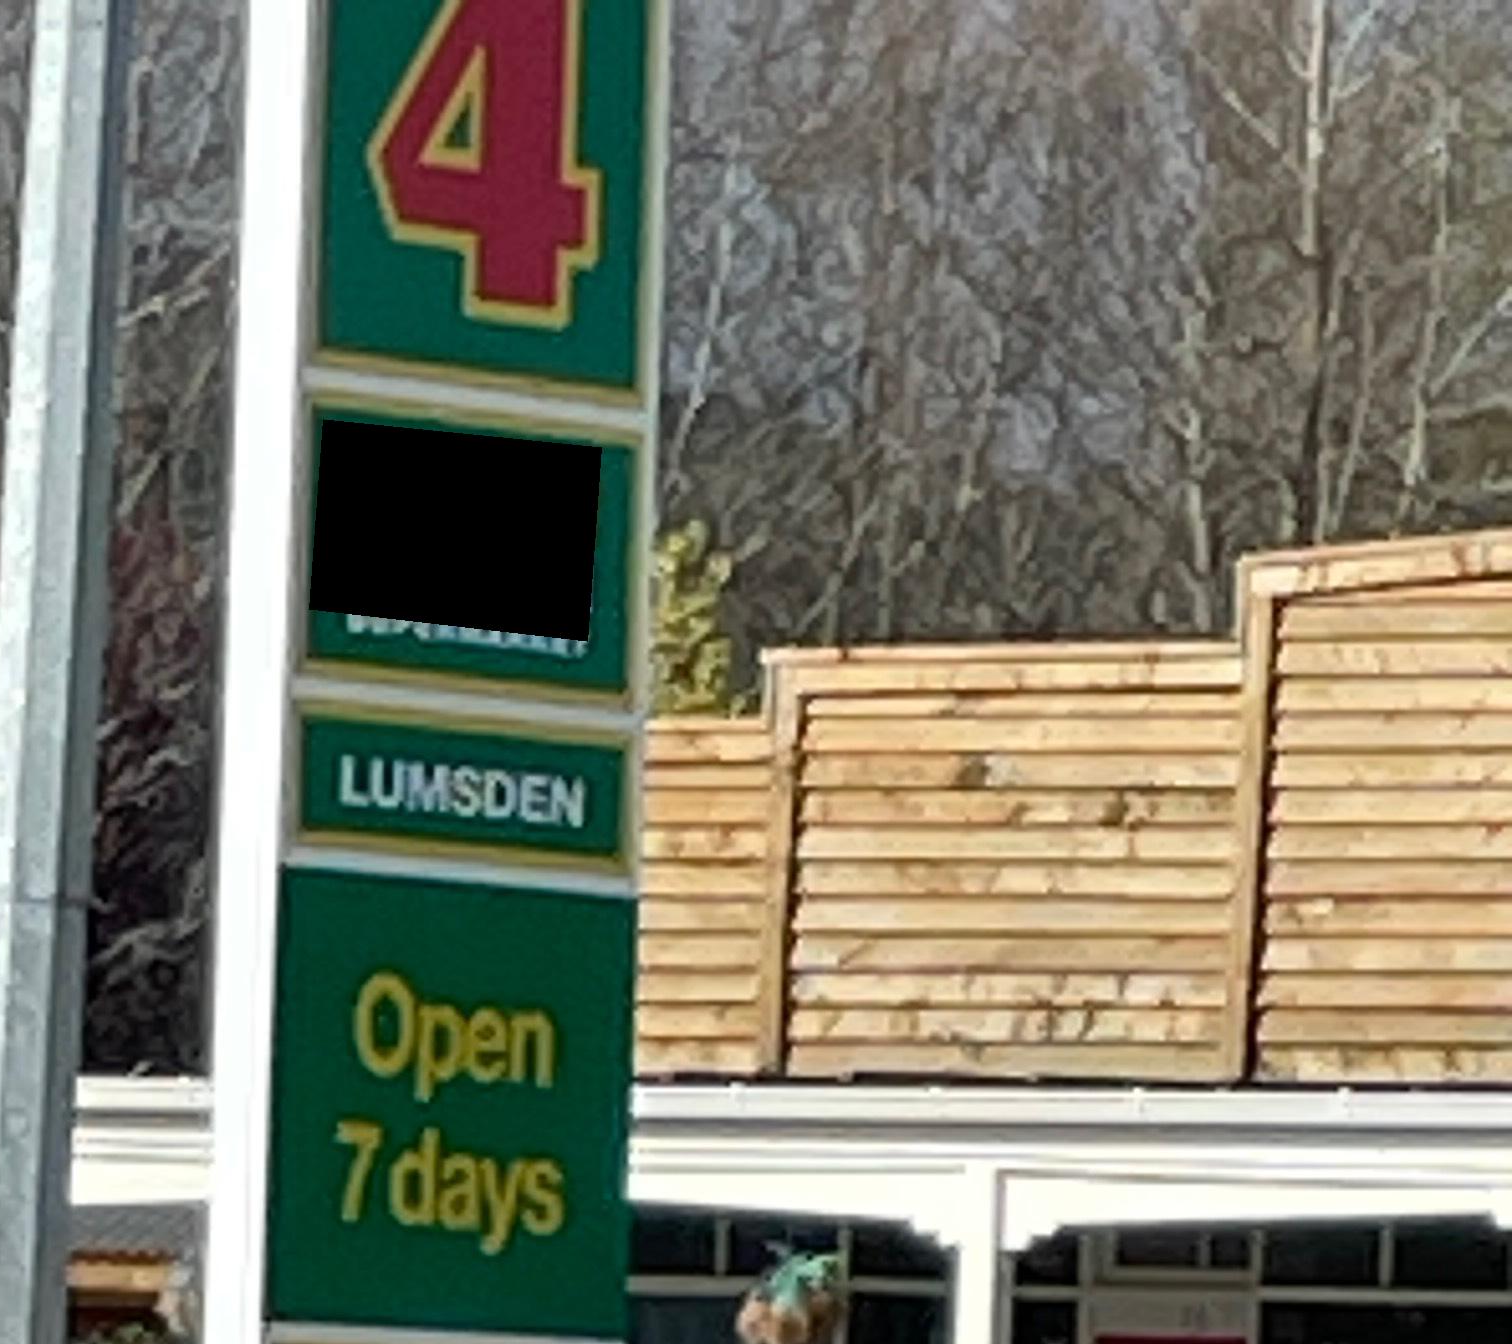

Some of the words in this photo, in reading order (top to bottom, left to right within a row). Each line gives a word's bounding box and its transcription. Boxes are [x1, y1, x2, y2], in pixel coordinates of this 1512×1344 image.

[365, 0, 603, 332] 4
[339, 754, 586, 828] LUMSDEN
[352, 971, 555, 1102] Open
[334, 1120, 382, 1223] 7
[389, 1126, 565, 1256] days
